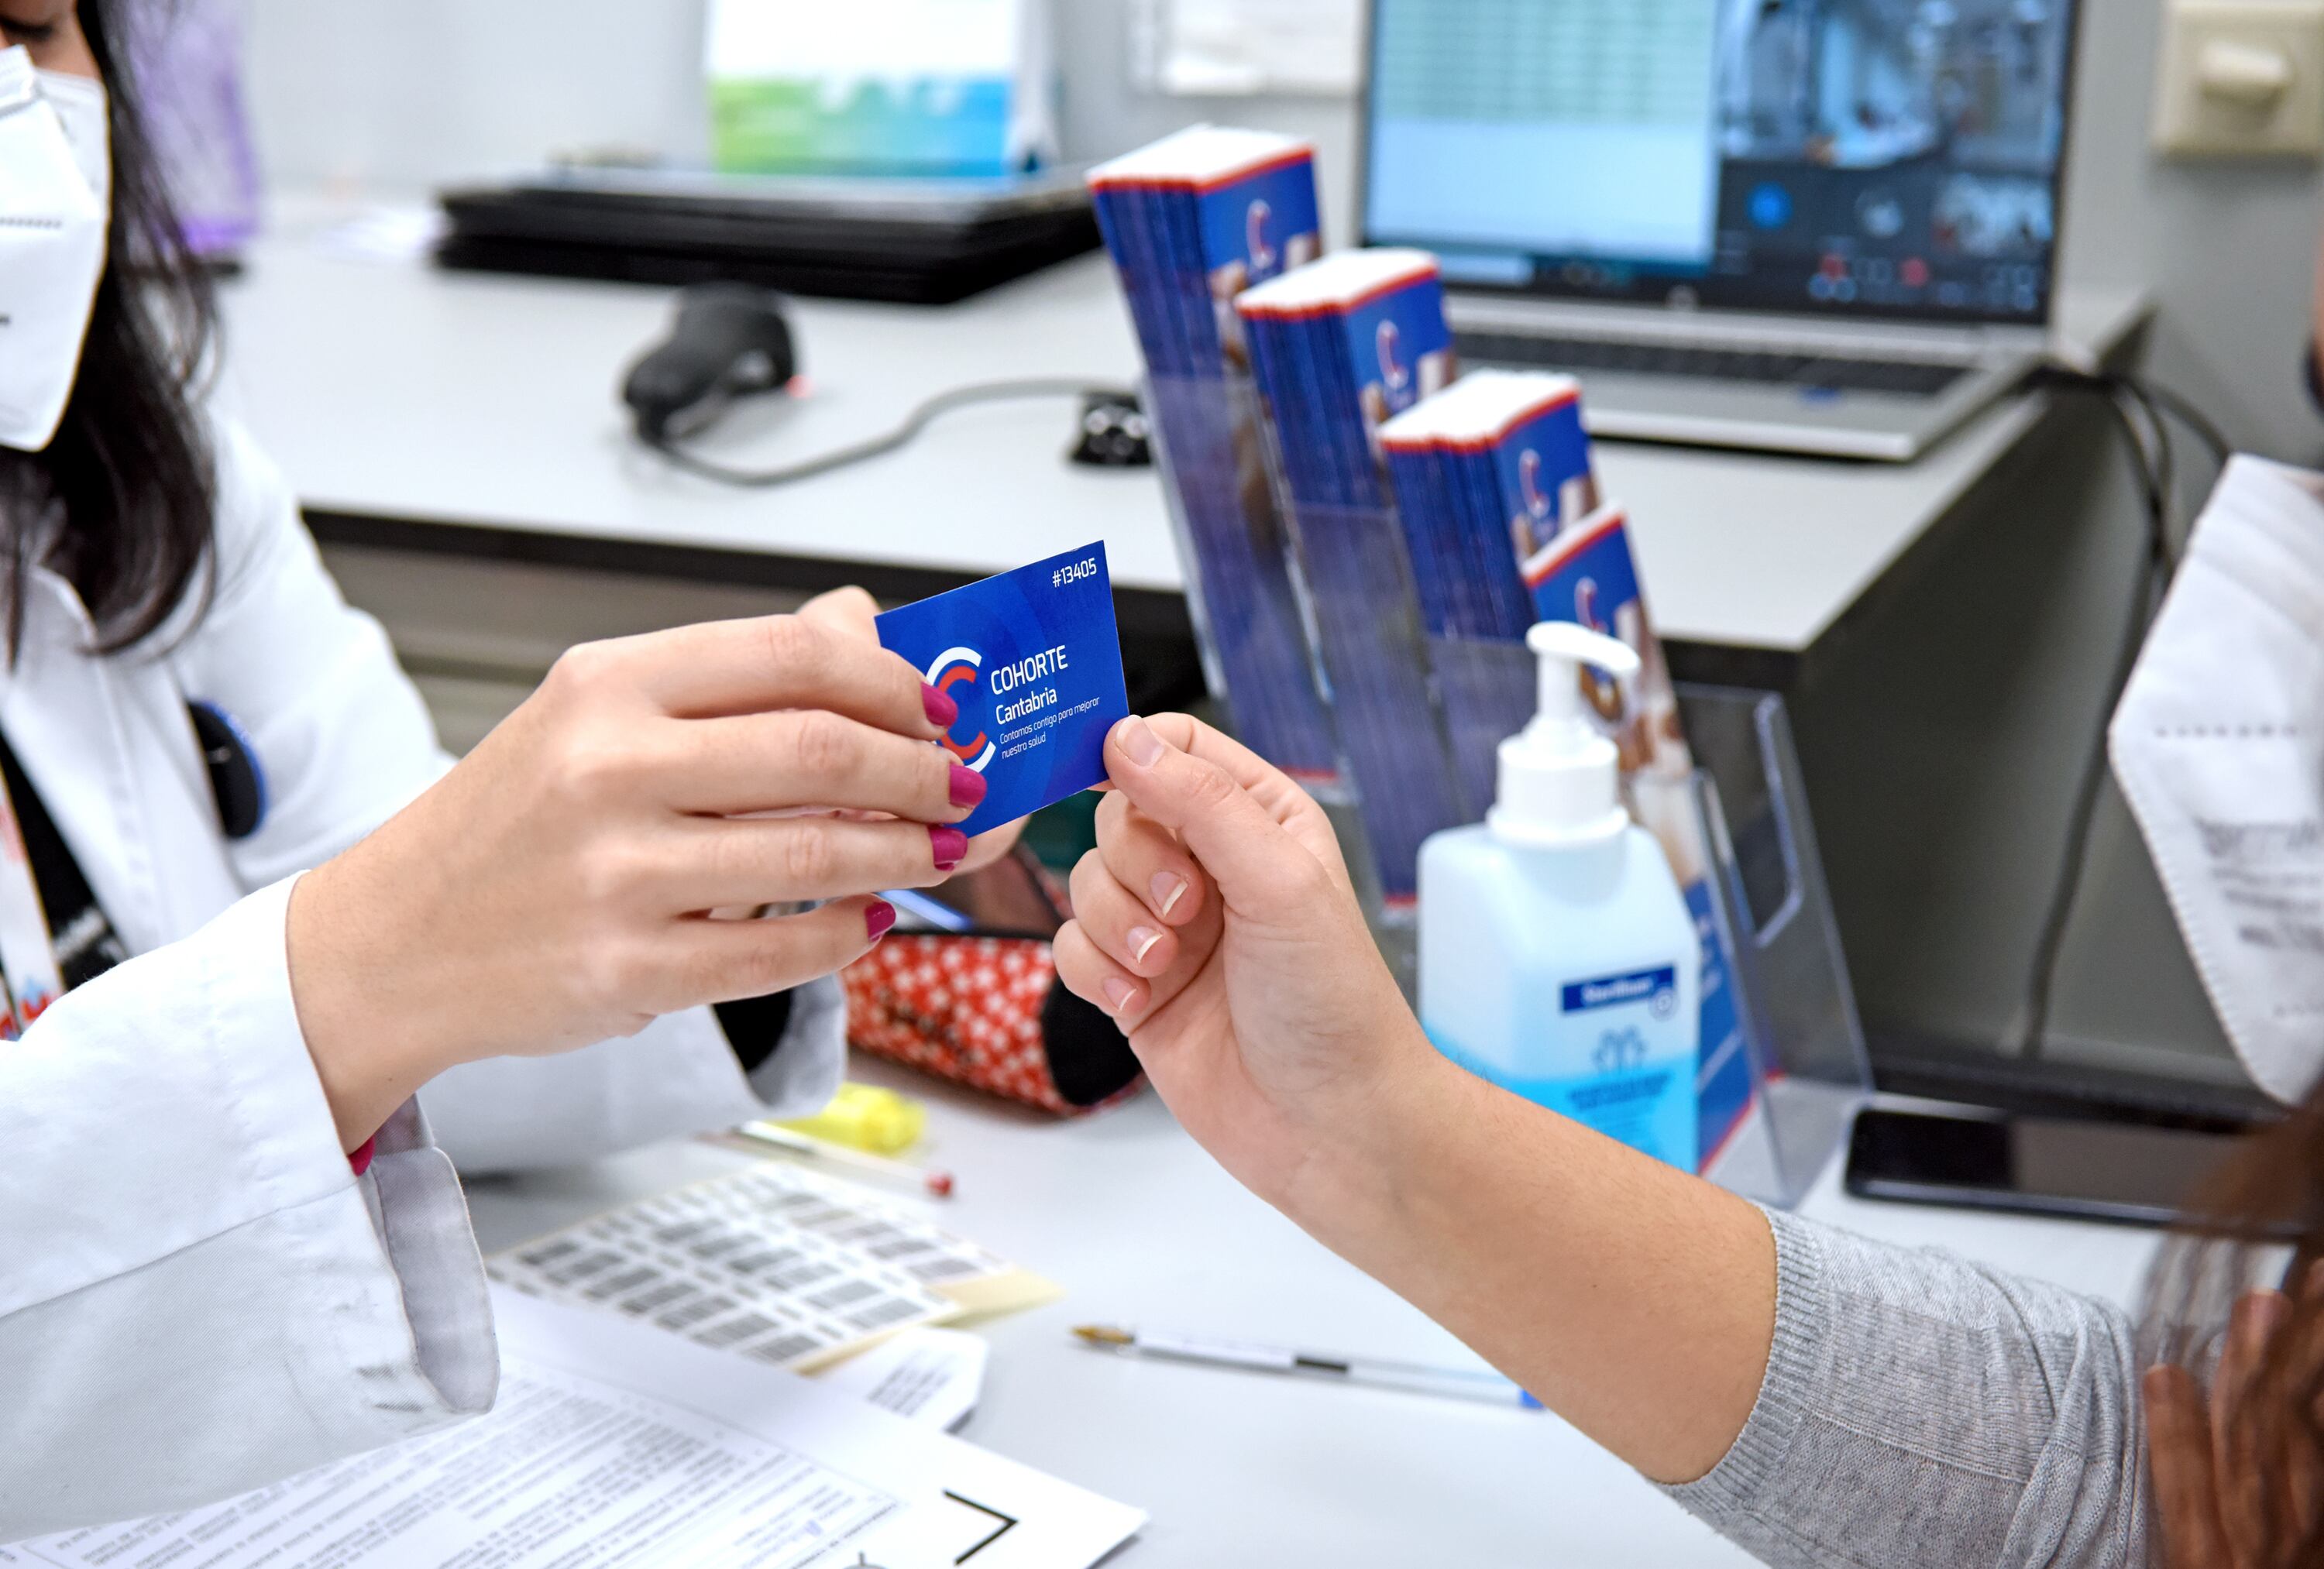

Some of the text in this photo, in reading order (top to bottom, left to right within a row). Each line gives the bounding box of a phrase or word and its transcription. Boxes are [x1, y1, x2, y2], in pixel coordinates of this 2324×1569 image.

[1052, 557, 1097, 588] #13405
[991, 644, 1068, 695] COHORTE
[995, 687, 1057, 725] Cantabria
[999, 696, 1100, 744] Contamos contigo para mejorar
[1002, 731, 1047, 760] nuestra salud
